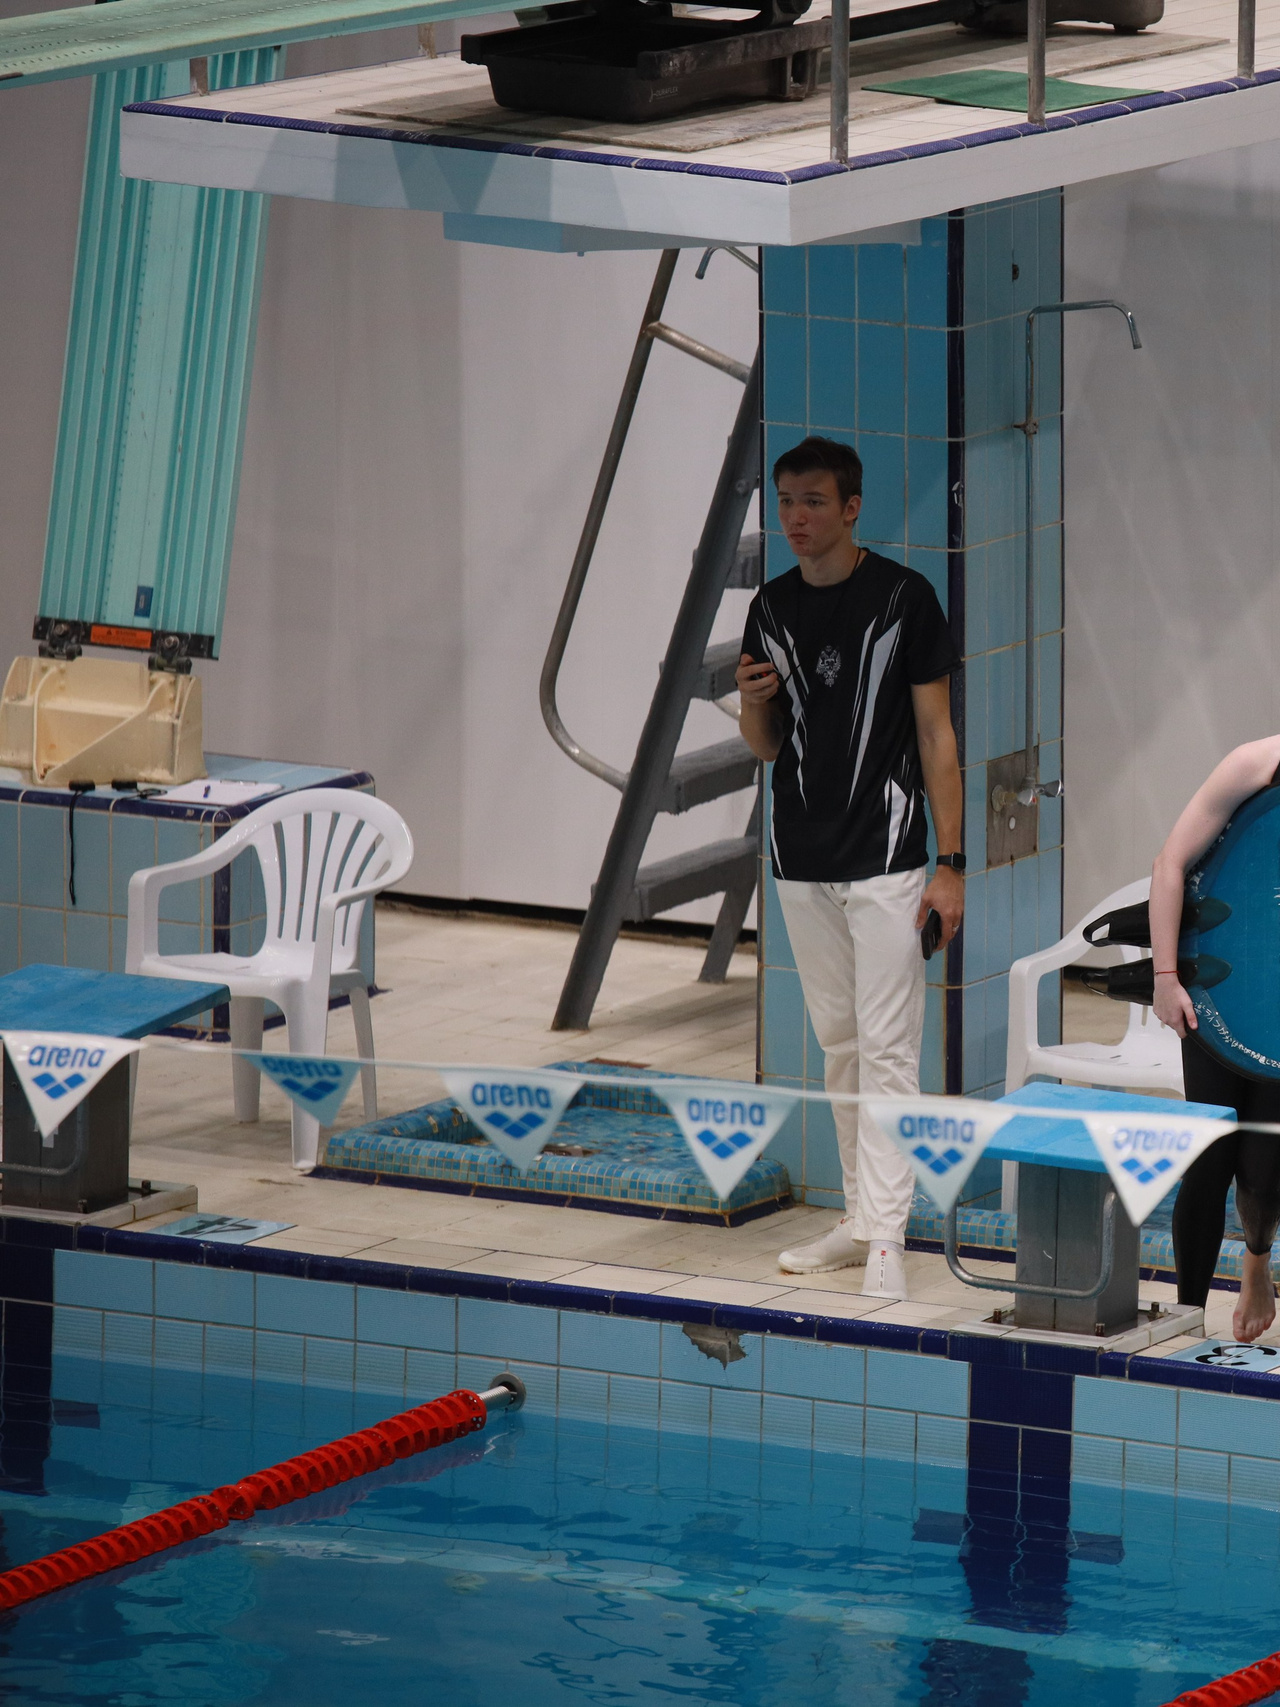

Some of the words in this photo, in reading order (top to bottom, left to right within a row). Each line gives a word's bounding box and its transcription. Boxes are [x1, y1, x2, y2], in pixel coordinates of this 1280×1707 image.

[28, 1045, 106, 1068] arena
[472, 1084, 552, 1109] arena
[688, 1099, 766, 1126] arena
[899, 1116, 976, 1143] arena
[1114, 1128, 1193, 1152] arena
[176, 1217, 258, 1235] 4
[1195, 1345, 1277, 1366] 3
